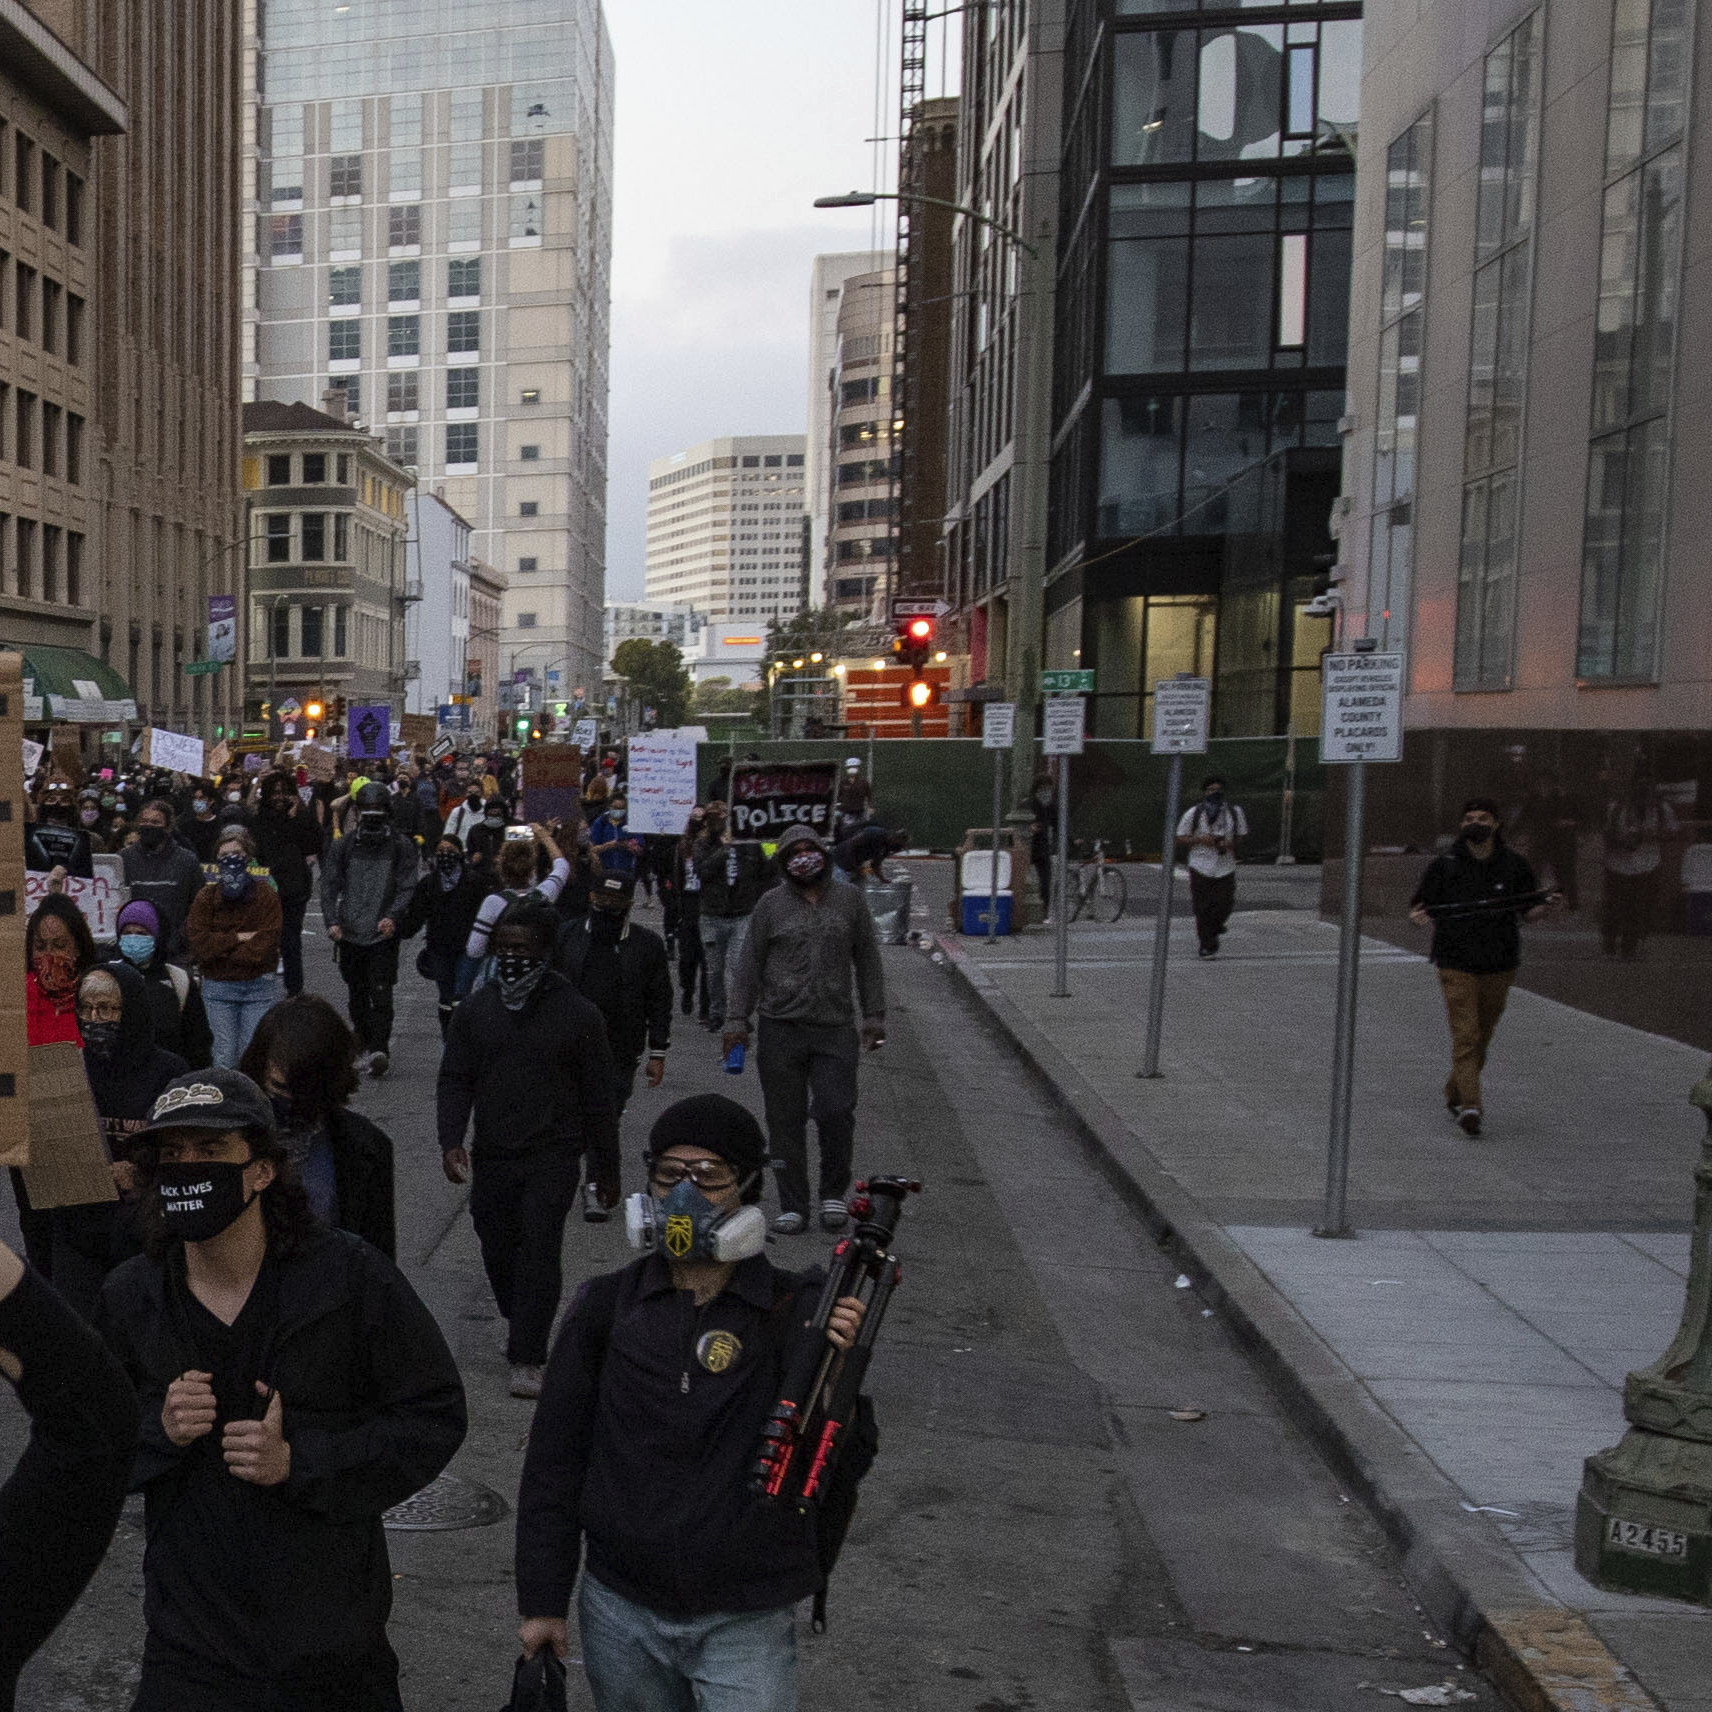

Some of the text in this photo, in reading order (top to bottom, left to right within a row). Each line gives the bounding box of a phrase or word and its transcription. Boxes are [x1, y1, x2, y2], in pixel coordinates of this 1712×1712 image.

[1329, 658, 1399, 671] NO PARKING
[1339, 697, 1385, 707] ALAMEDA
[1341, 712, 1382, 722] COUNTY
[1334, 727, 1388, 737] PLACARDS
[732, 800, 827, 831] POLICE
[181, 1179, 214, 1197] LIVES
[1609, 1519, 1687, 1556] A2455
